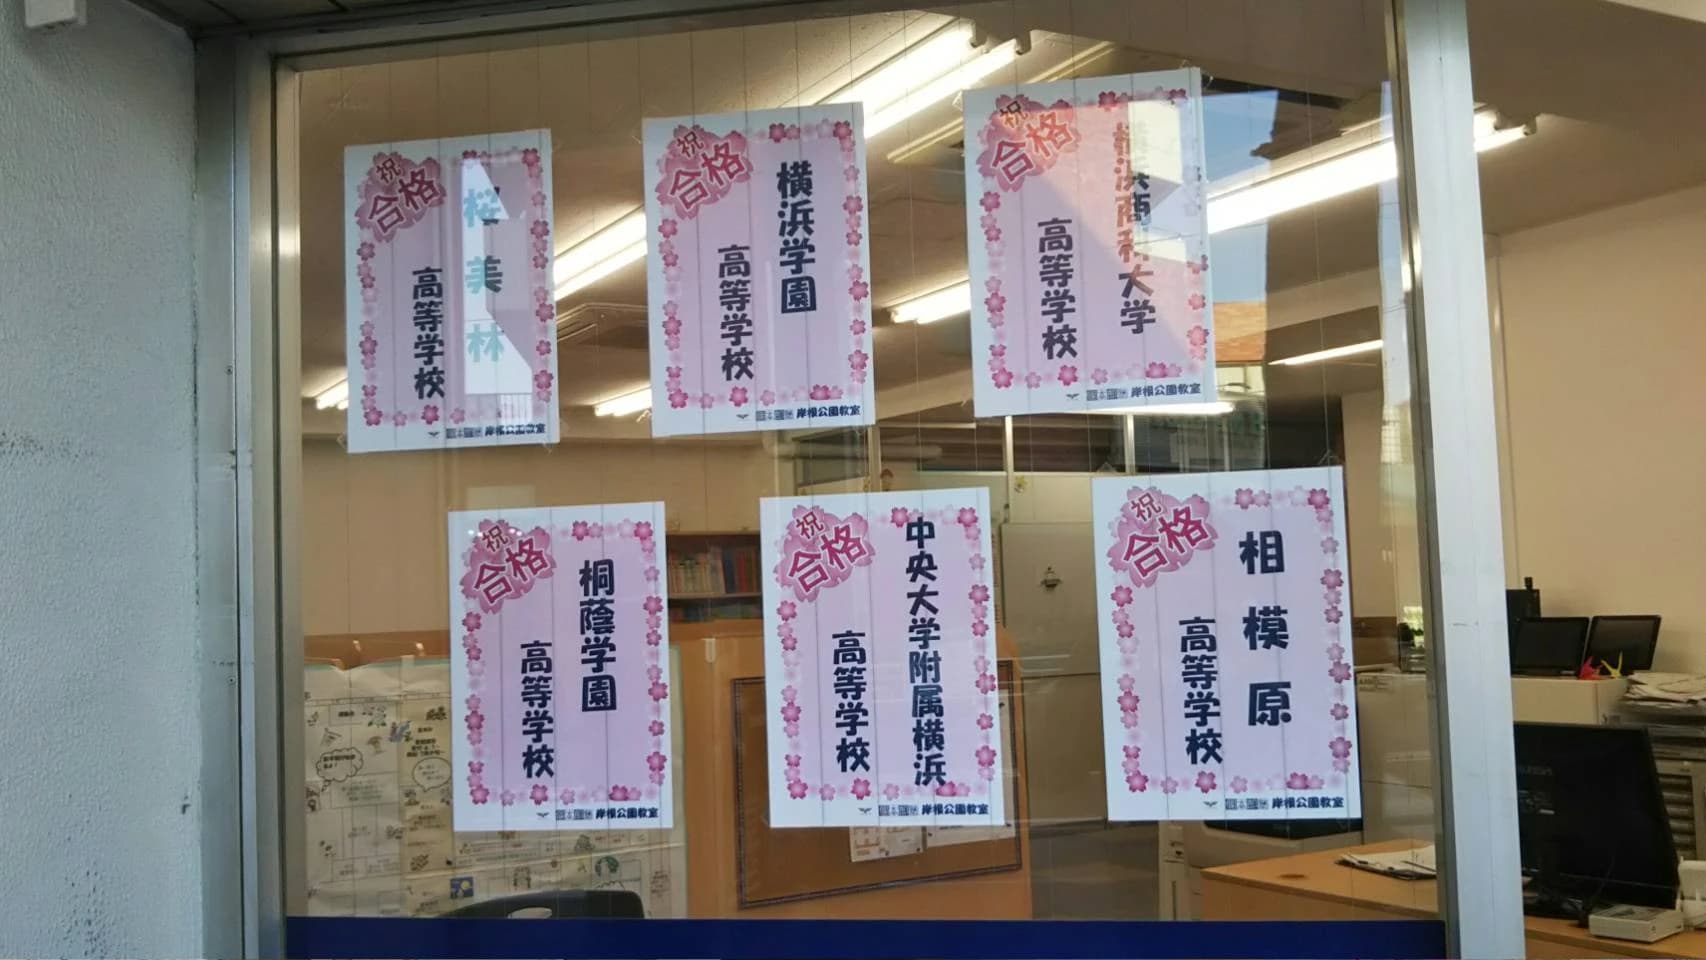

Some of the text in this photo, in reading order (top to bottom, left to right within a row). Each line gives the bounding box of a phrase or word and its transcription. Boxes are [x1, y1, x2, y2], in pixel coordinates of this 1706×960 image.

[676, 131, 705, 158] 祝
[992, 111, 1074, 182] 合格
[999, 101, 1027, 128] 祝
[369, 168, 441, 234] 合格
[376, 158, 402, 181] 祝
[669, 142, 747, 210] 合格
[464, 186, 504, 363] 桜美林
[776, 161, 817, 314] 横浜学園
[718, 244, 755, 382] 高等学校
[1037, 217, 1078, 360] 高等学校
[412, 266, 445, 401] 高等学校
[481, 525, 511, 553] 祝
[795, 510, 826, 540] 祝
[1123, 504, 1210, 578] 合格
[1130, 492, 1163, 523] 祝
[474, 538, 549, 604] 合格
[788, 522, 868, 593] 合格
[579, 558, 617, 713] 桐蔭学園
[905, 516, 948, 787] 中央大学附属横浜
[1239, 529, 1293, 727] 相模原
[520, 640, 555, 780] 高等学校
[832, 630, 871, 774] 高等学校
[1179, 616, 1224, 766] 高等学校
